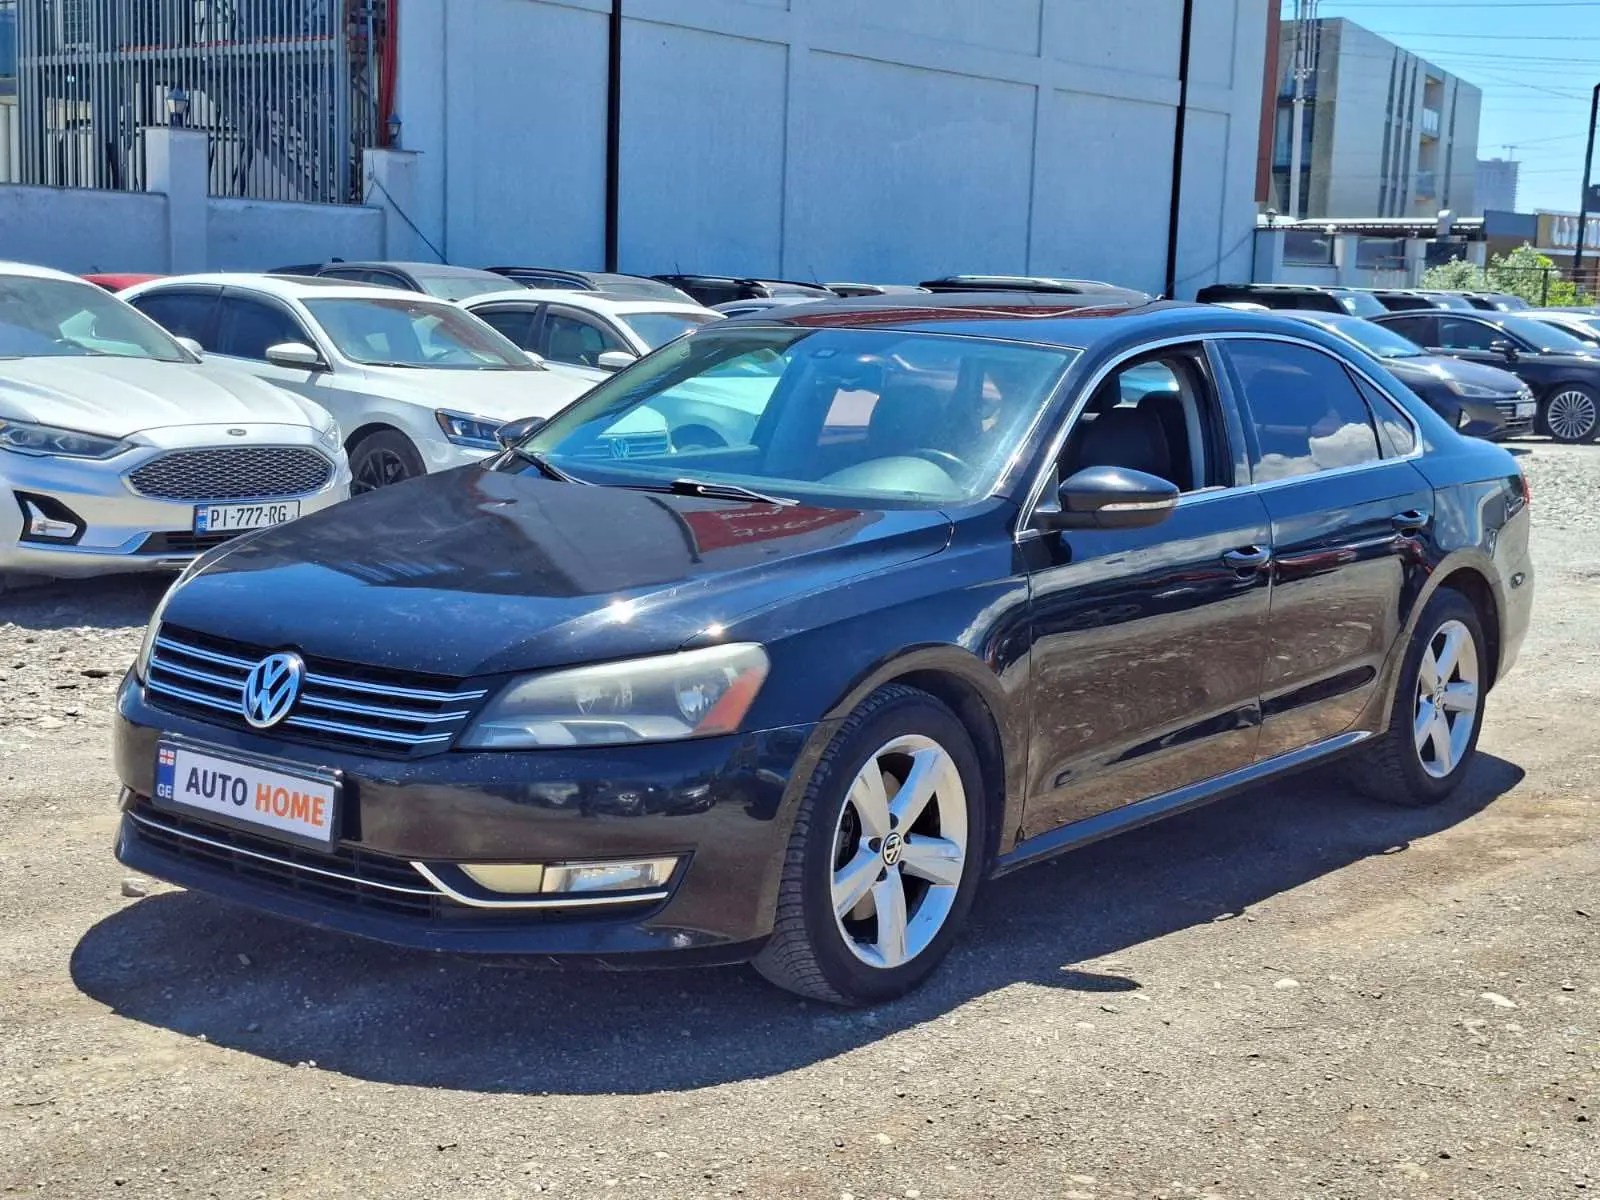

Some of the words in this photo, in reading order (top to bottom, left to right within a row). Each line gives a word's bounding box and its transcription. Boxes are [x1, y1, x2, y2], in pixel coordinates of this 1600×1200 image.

[210, 505, 287, 528] PI-777-RG
[242, 652, 305, 728] VW
[157, 783, 172, 799] GE
[185, 767, 248, 806] AUTO
[255, 783, 326, 827] HOME
